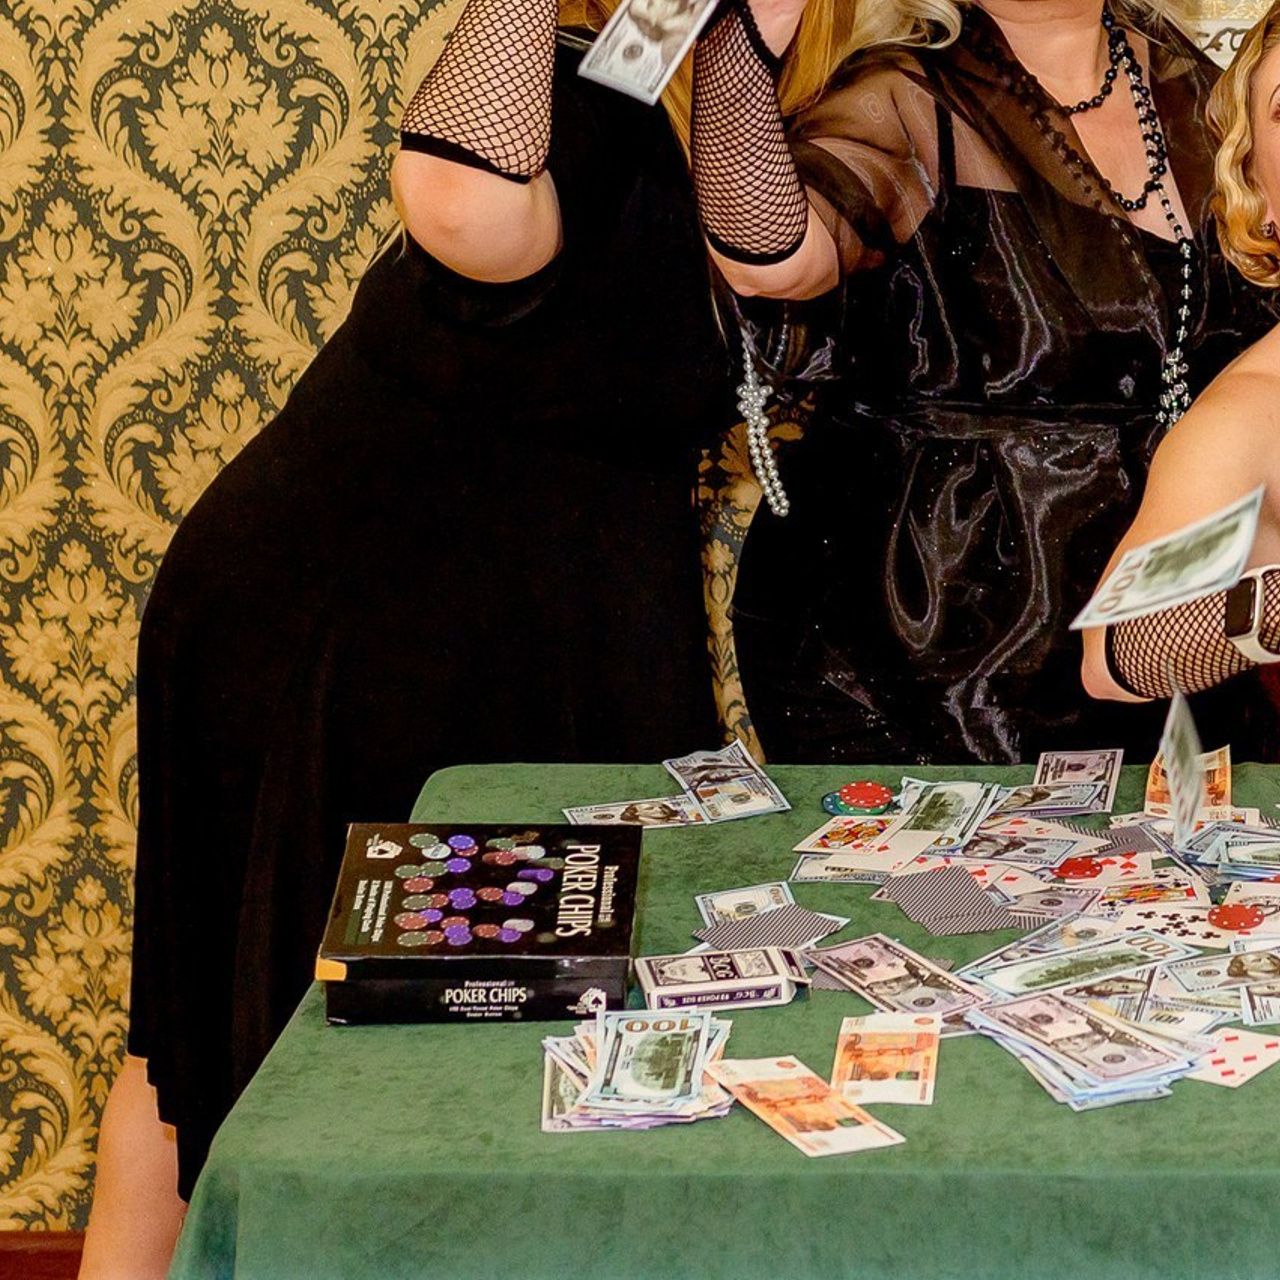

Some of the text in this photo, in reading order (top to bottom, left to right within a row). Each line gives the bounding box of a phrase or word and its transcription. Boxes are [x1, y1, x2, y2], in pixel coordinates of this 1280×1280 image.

[1097, 552, 1143, 615] 100
[555, 844, 601, 937] POKER CHIPS
[1124, 934, 1179, 958] 100
[709, 956, 734, 978] BCG
[445, 987, 527, 1004] POKER CHIPS
[625, 1018, 691, 1033] 100
